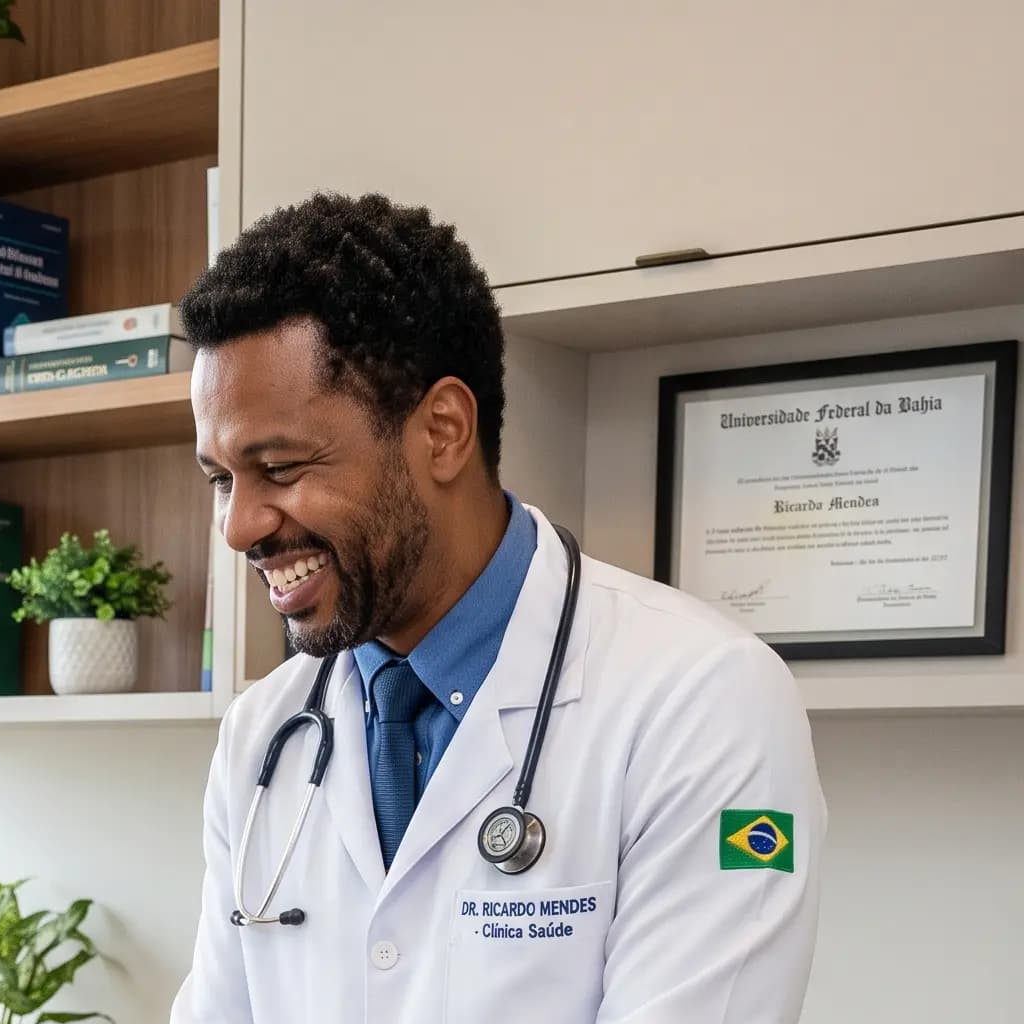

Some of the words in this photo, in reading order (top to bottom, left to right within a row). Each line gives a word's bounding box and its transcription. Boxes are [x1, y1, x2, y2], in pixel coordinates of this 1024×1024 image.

[720, 407, 810, 429] Universidade
[814, 401, 870, 423] Federal
[875, 400, 892, 415] da
[897, 396, 943, 415] Bahia
[461, 901, 479, 916] DR.
[482, 901, 536, 917] RICARDO
[539, 897, 597, 916] MENDES
[482, 922, 523, 938] Clínica
[528, 921, 573, 938] Saúde
